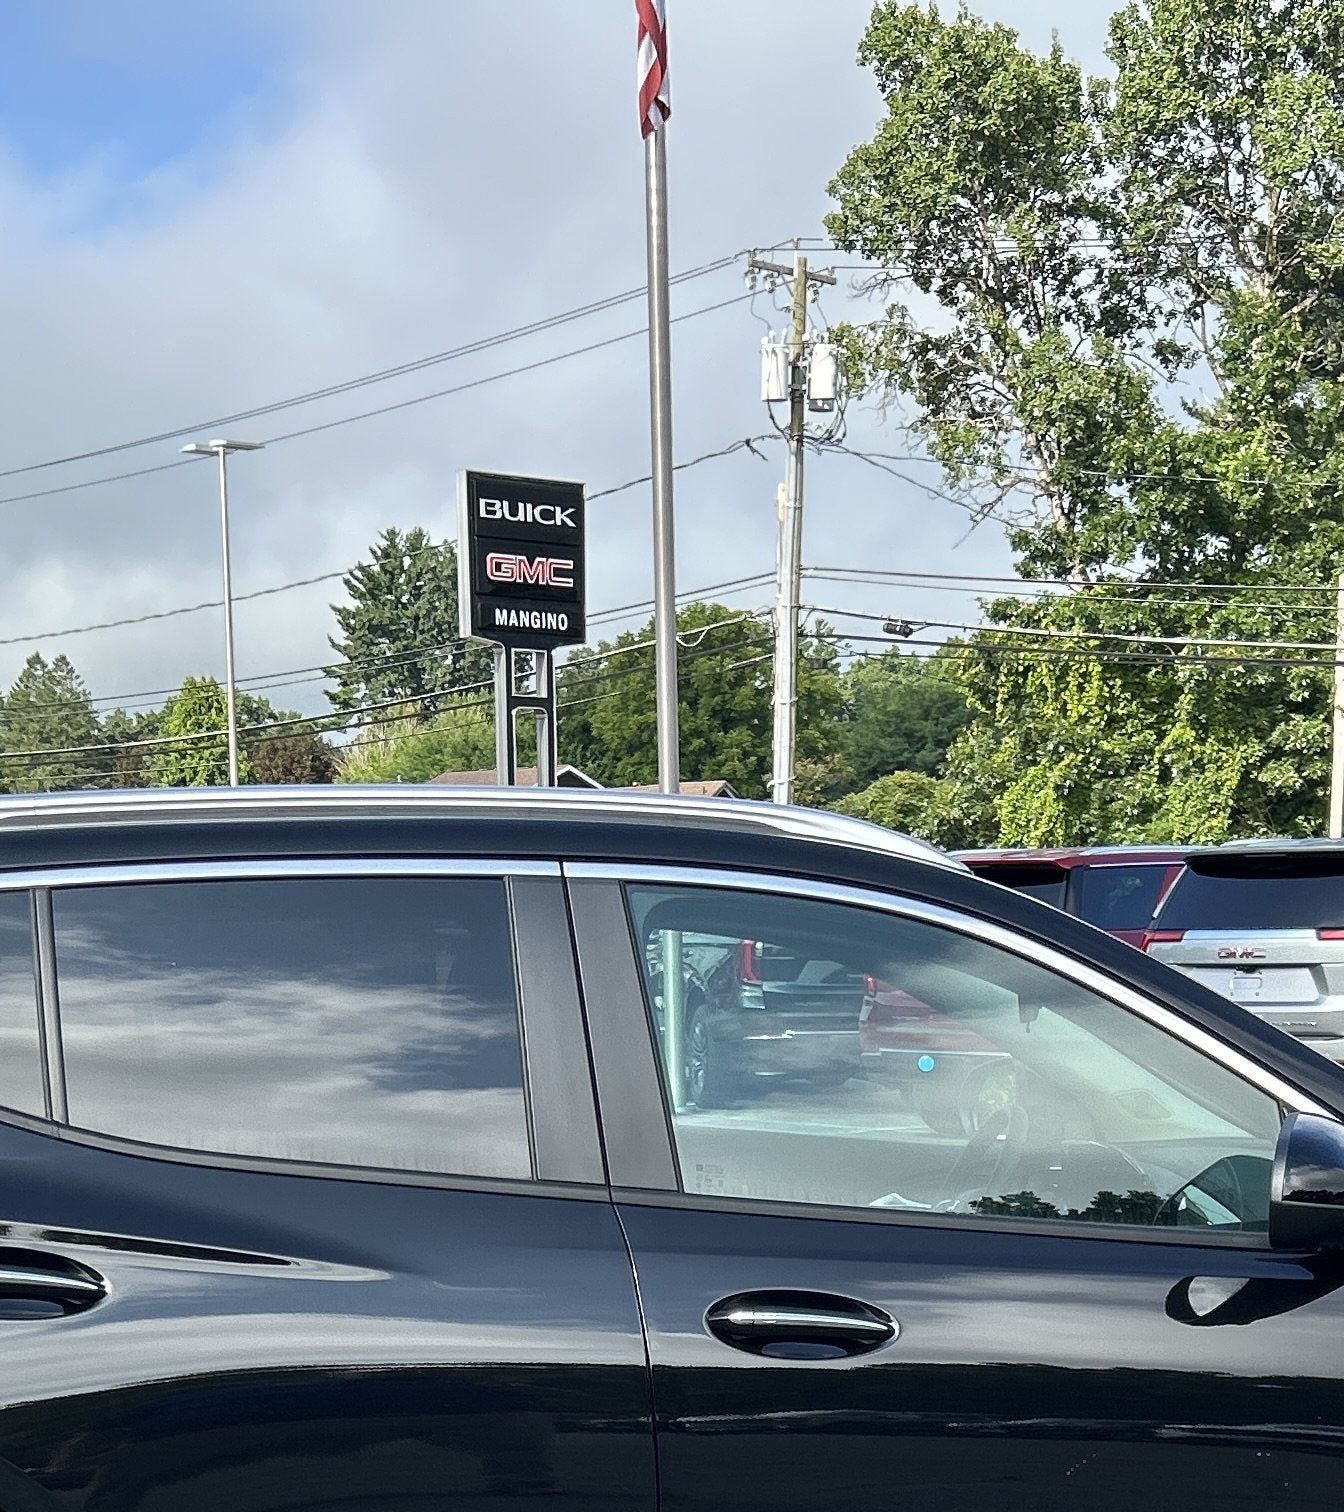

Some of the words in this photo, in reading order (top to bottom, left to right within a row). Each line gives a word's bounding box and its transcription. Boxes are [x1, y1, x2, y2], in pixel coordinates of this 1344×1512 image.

[478, 497, 577, 528] BUICK
[485, 552, 574, 588] GMC
[494, 607, 569, 632] MANGINO
[1216, 946, 1267, 959] GMC
